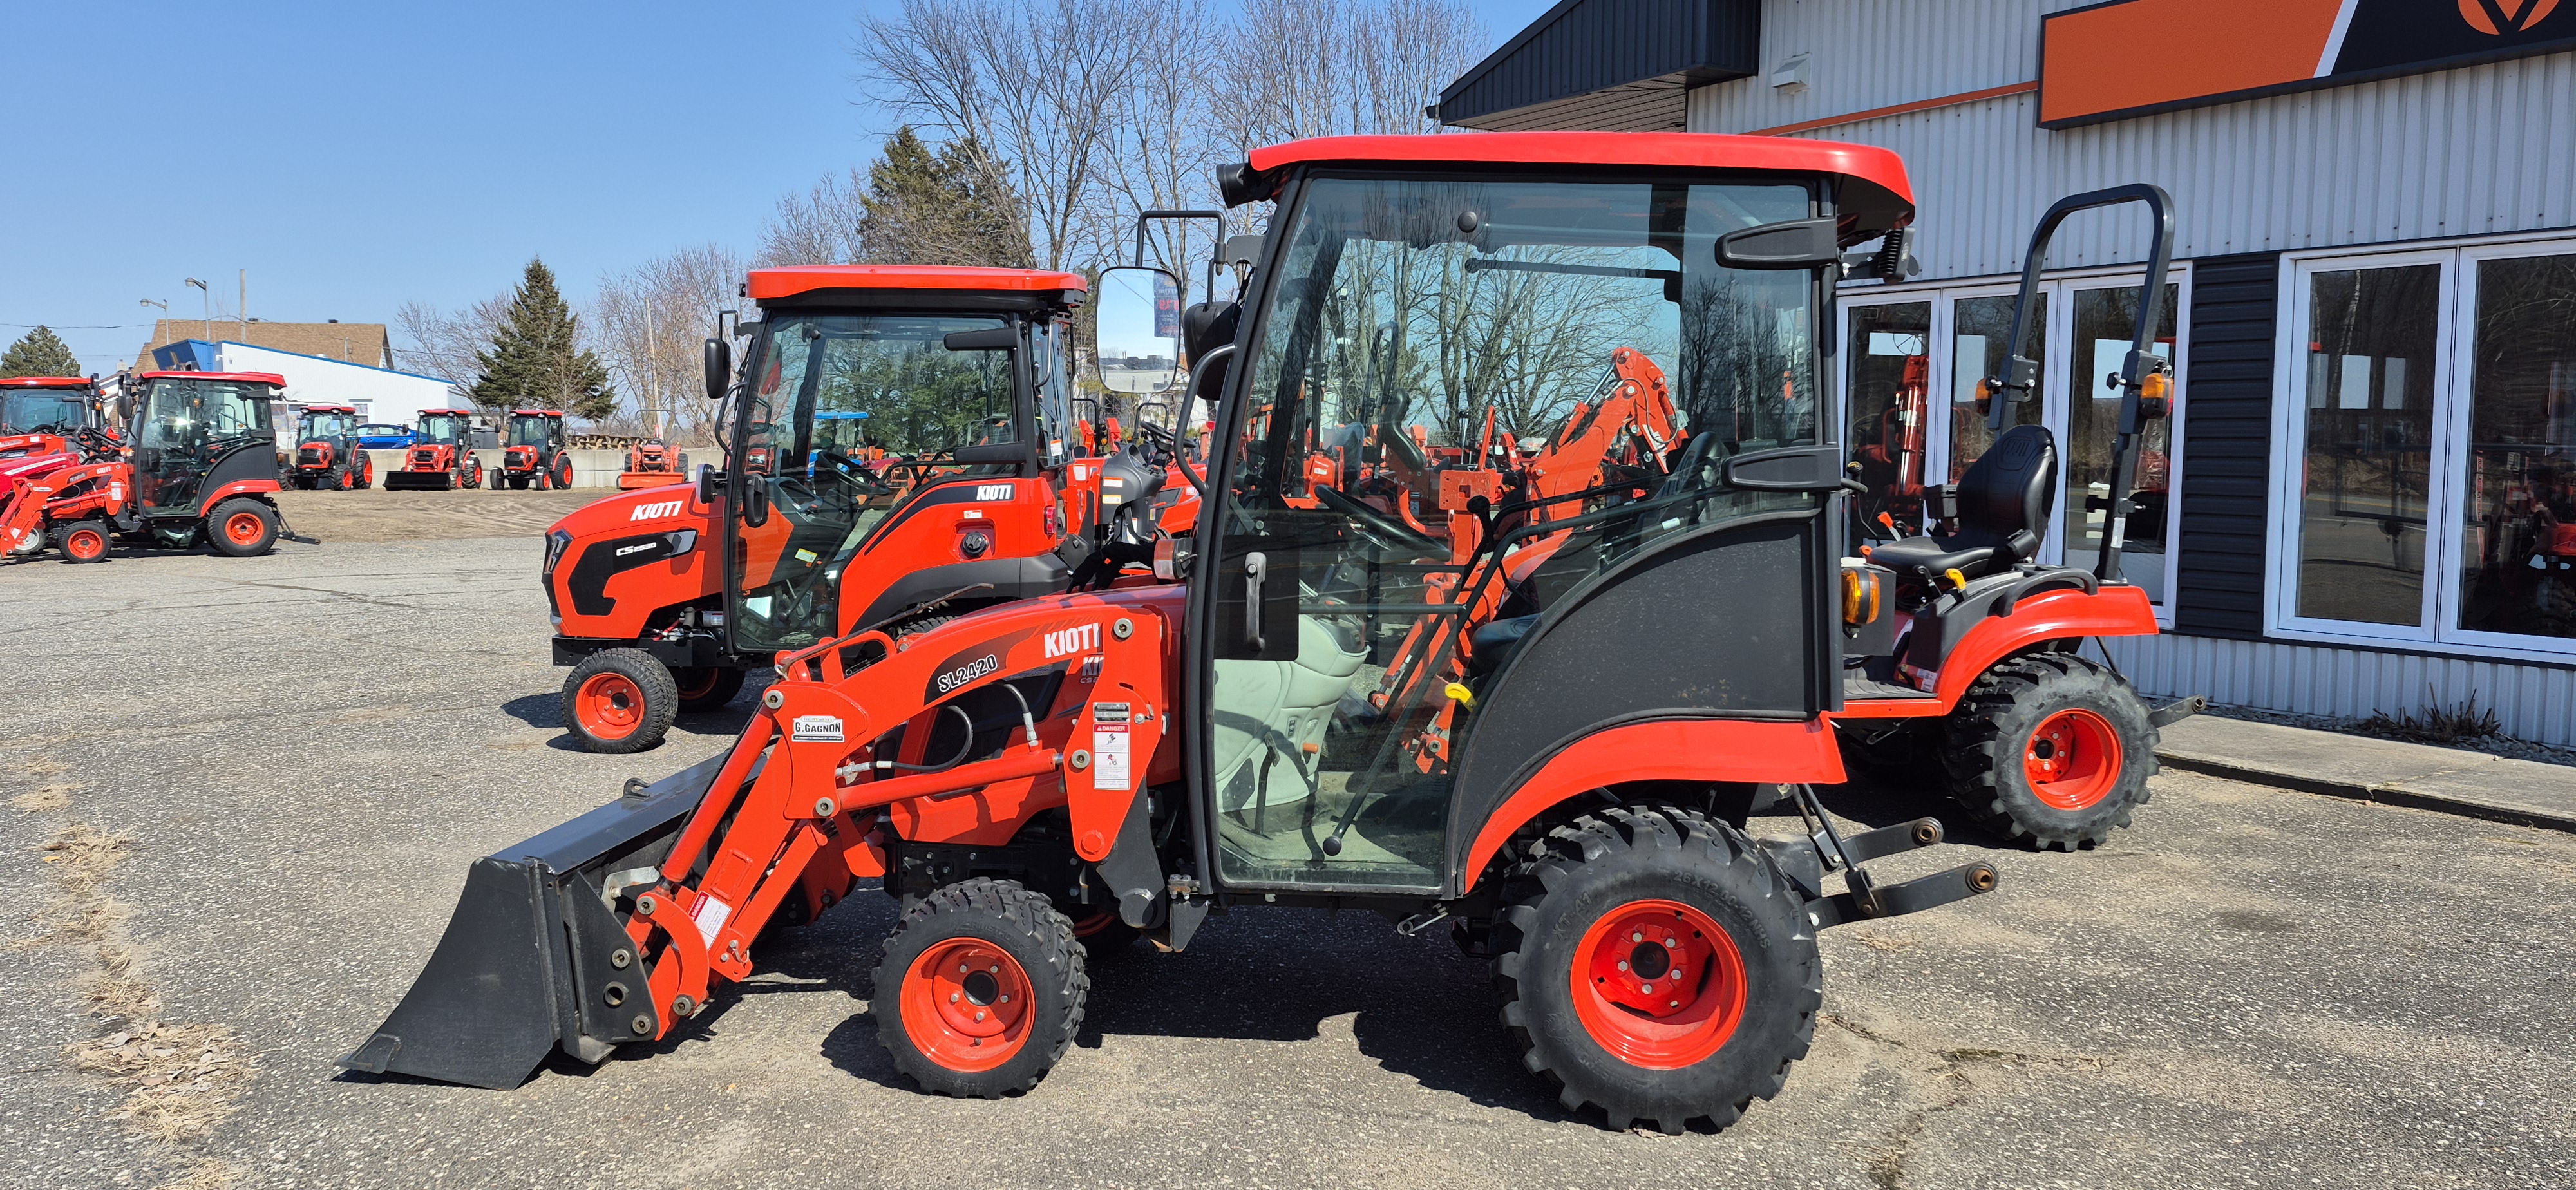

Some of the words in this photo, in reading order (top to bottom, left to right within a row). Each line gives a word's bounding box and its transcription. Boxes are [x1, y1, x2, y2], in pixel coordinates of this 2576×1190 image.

[976, 484, 1012, 501] KIOTI
[630, 500, 683, 521] KIOTI
[1044, 622, 1100, 658] KIOTI
[937, 654, 998, 692] SL2420
[690, 894, 706, 917] DANGER
